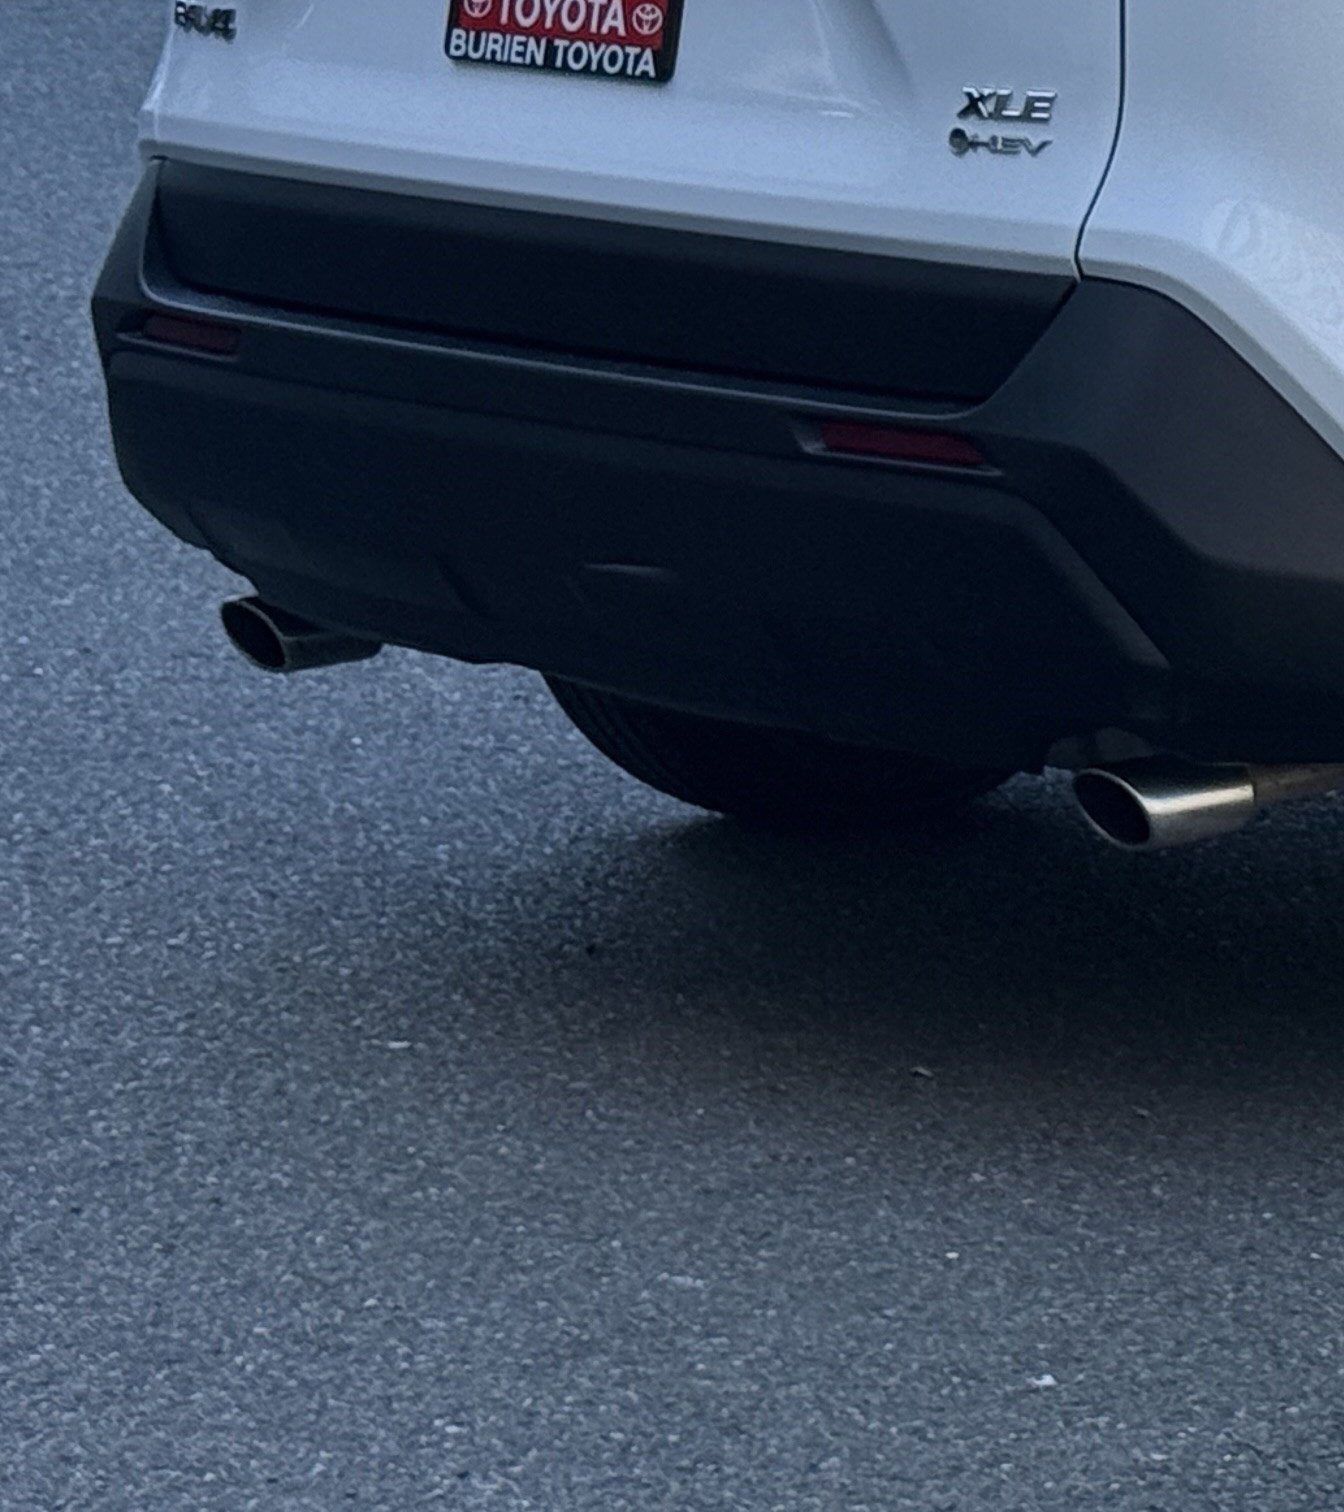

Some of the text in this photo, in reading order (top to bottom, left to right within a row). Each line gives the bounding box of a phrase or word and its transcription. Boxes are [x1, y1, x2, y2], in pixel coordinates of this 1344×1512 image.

[449, 28, 657, 78] BURIEN TOYOTA
[956, 86, 1057, 123] XLE
